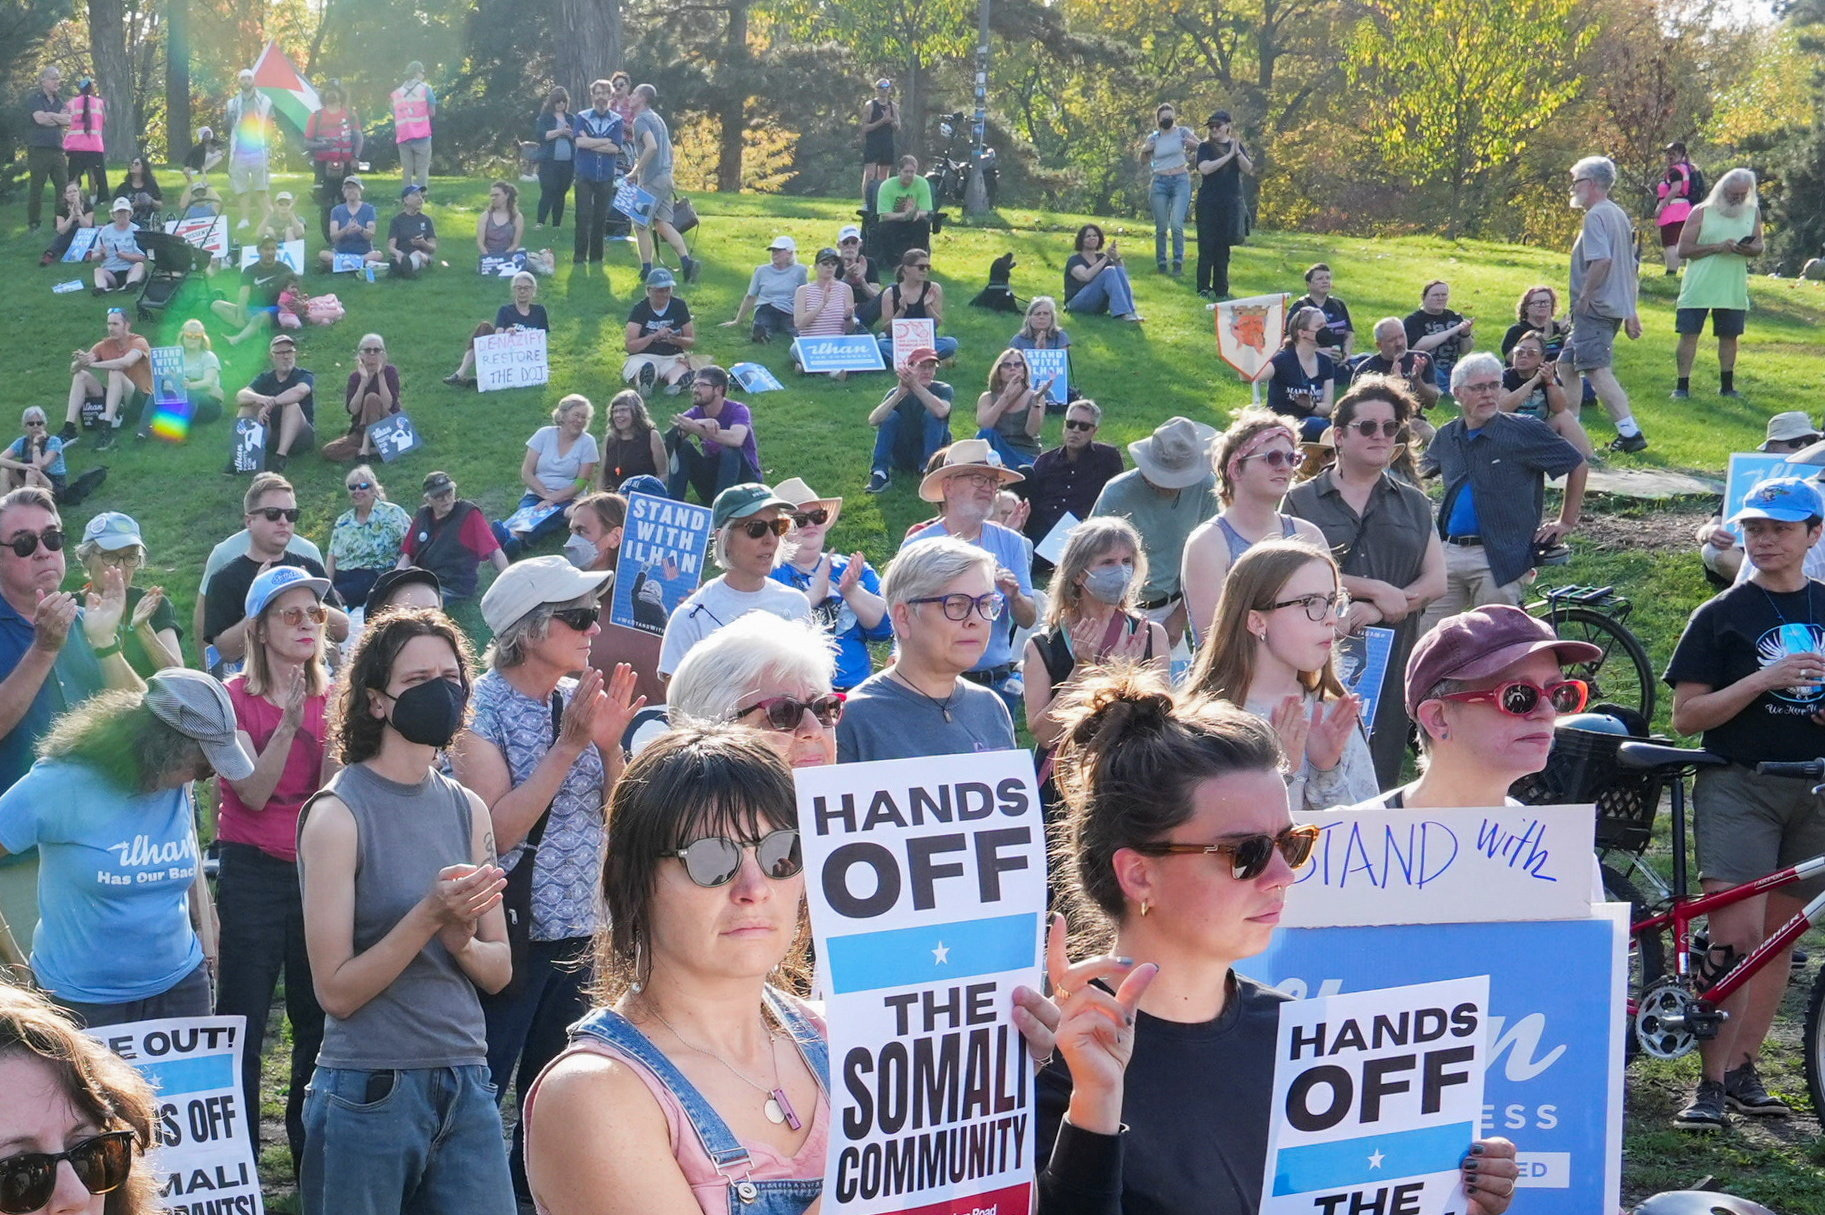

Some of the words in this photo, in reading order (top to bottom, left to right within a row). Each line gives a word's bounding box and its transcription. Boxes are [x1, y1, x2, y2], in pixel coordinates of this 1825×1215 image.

[151, 349, 181, 359] STAND
[155, 357, 180, 367] WITH
[482, 349, 541, 365] RESTORE
[1027, 351, 1063, 359] STAND
[490, 368, 513, 384] THE
[1032, 366, 1064, 376] LHAN
[632, 499, 706, 531] STAND
[637, 520, 695, 551] WITH
[812, 777, 1029, 836] HANDS
[97, 870, 132, 885] Has
[136, 870, 166, 883] Our
[168, 866, 196, 880] Bac
[821, 826, 1032, 919] OFF
[884, 981, 998, 1037] THE
[142, 1026, 237, 1057] OUT!
[1289, 1002, 1479, 1061] HANDS
[842, 1023, 1027, 1141] SOMALI
[1285, 1045, 1475, 1132] OFF
[187, 1095, 237, 1144] OFF
[1480, 1103, 1559, 1130] ESS
[835, 1112, 1028, 1205] COMMUNITY
[159, 1162, 250, 1198] MALI
